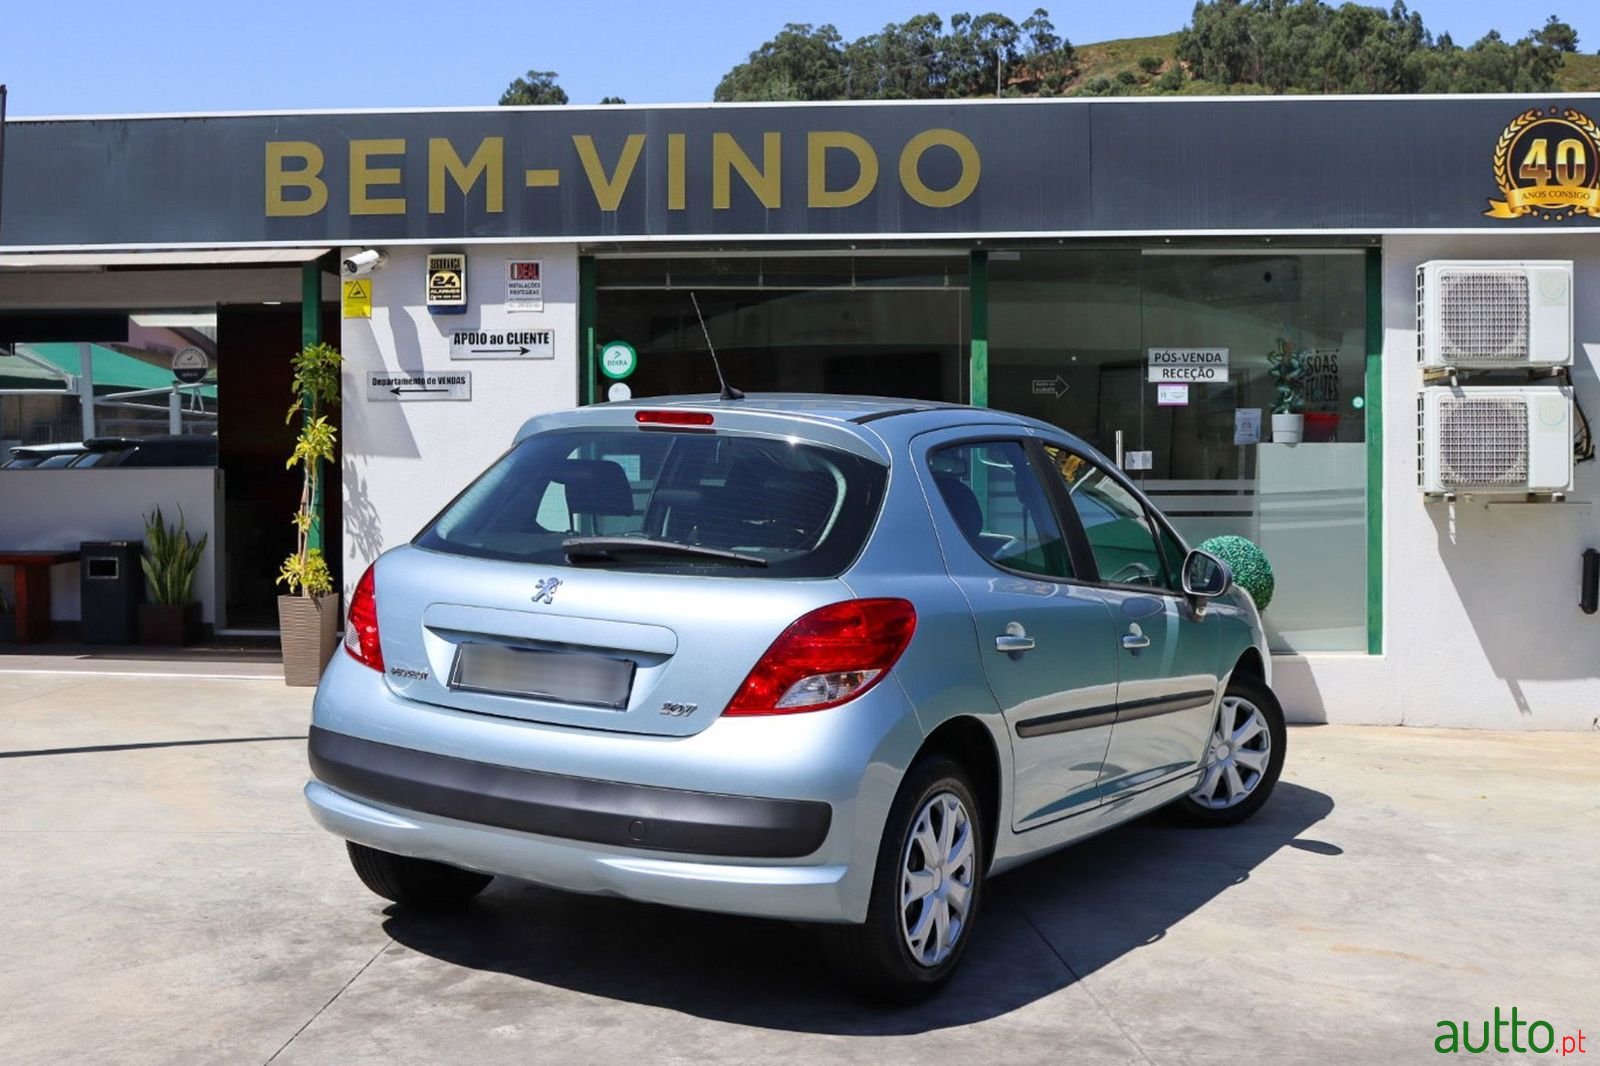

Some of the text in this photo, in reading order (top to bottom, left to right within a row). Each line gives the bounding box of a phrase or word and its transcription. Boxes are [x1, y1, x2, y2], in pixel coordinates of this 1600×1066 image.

[1519, 138, 1586, 187] 40
[264, 128, 981, 218] BEM-VINDO
[1522, 190, 1591, 200] ANOS CONSIGO
[432, 275, 456, 287] 24
[508, 281, 541, 289] INSTALAÇÕES
[453, 331, 550, 345] APOIO ao CLIENTE
[1154, 350, 1222, 363] PÓS-VENDA
[1162, 366, 1215, 381] RECEÇÃO
[372, 376, 466, 387] Departamento de VENDAS
[659, 701, 698, 718] 207
